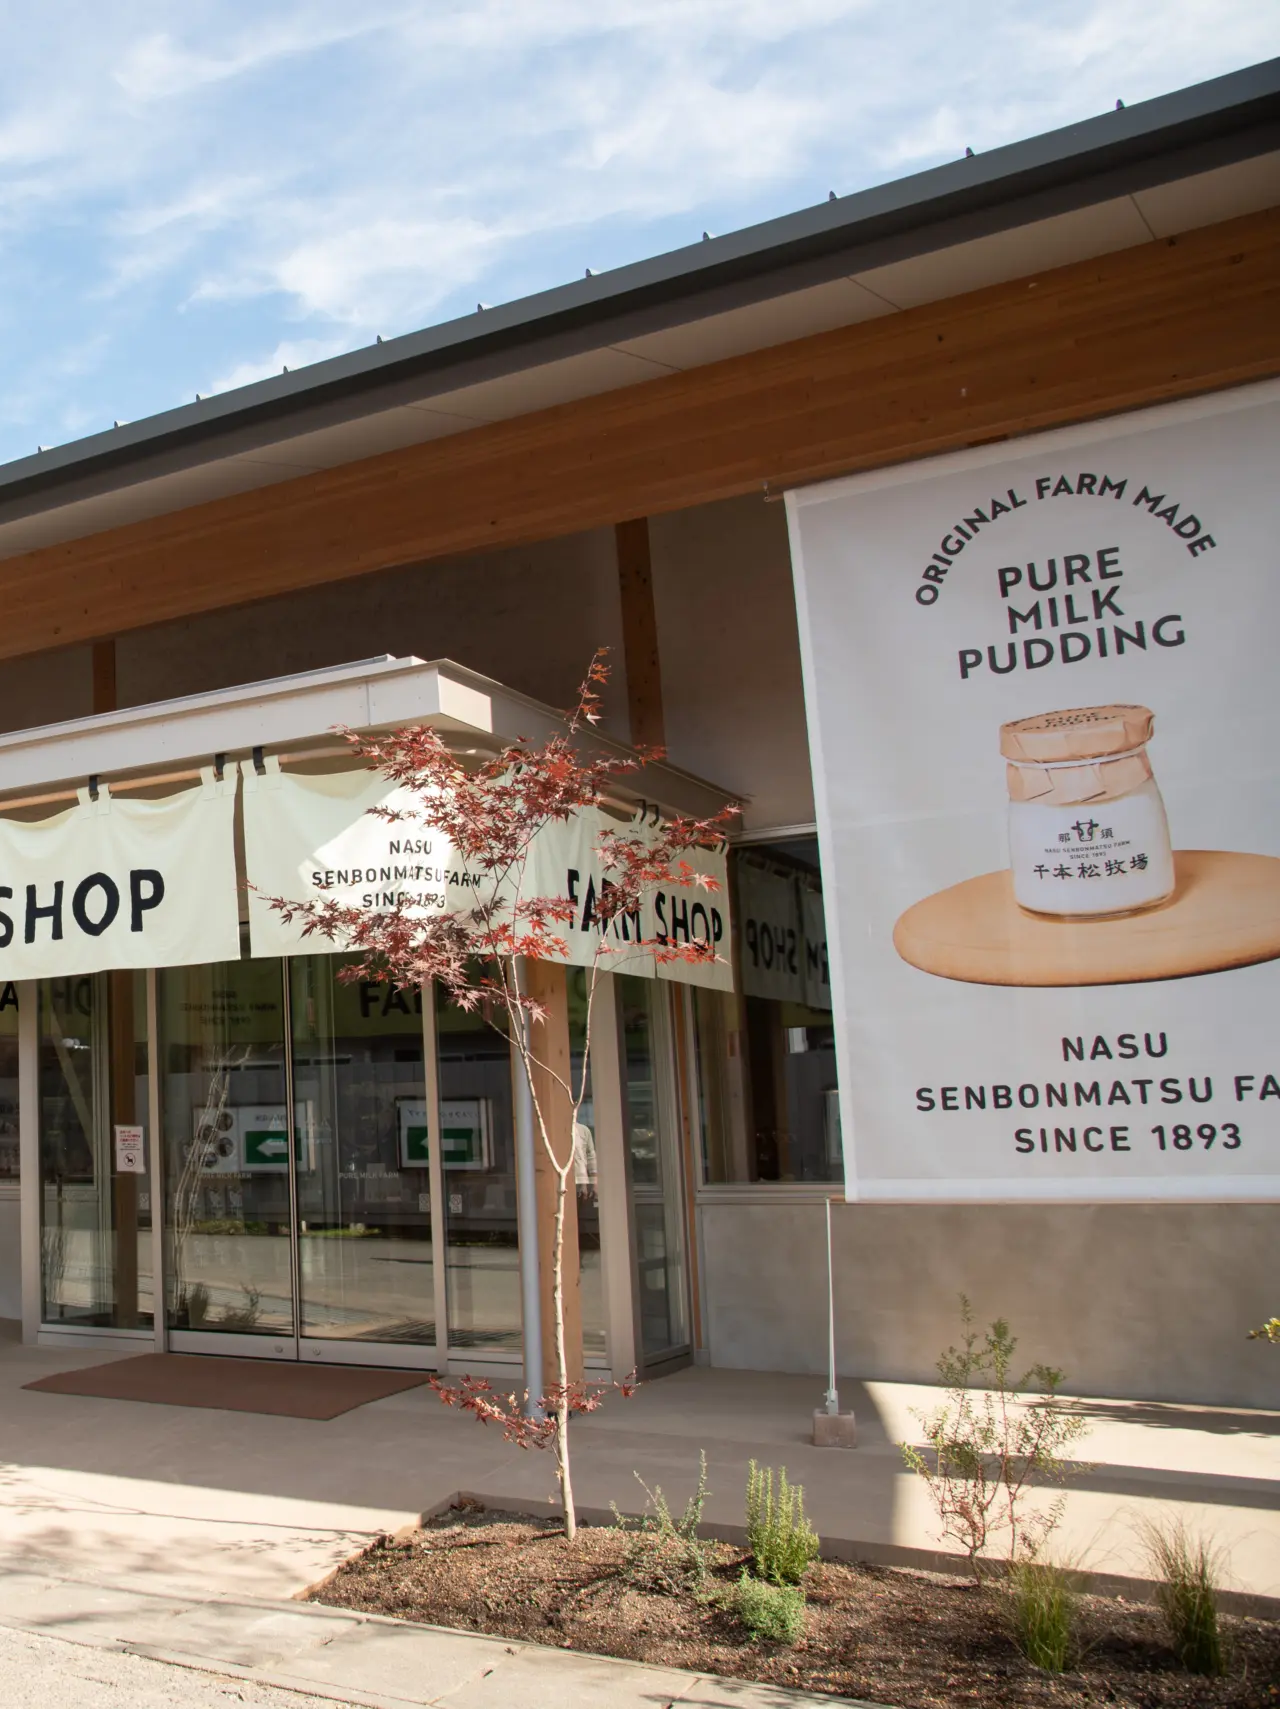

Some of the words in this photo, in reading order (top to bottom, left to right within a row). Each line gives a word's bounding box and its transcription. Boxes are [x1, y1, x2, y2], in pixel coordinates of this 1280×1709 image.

[916, 489, 1027, 606] ORIGINAL
[1035, 472, 1128, 501] FARM
[1132, 486, 1217, 558] MADE
[997, 546, 1124, 598] PURE
[1007, 585, 1125, 634] MILK
[958, 614, 1186, 679] PUDDING
[389, 839, 432, 855] NASU
[1062, 844, 1112, 853] SENBONMATSU
[312, 865, 442, 885] SENBONMATSU
[443, 869, 481, 888] FARM
[1033, 853, 1149, 880] 千本松牧場
[655, 891, 723, 959] SHOP
[1061, 1031, 1169, 1062] NASU
[916, 1075, 1213, 1112] SENBONMATSU
[1234, 1074, 1280, 1101] FA
[1014, 1125, 1131, 1153] SINCE
[1150, 1122, 1242, 1151] 1893
[339, 1172, 358, 1180] PURE
